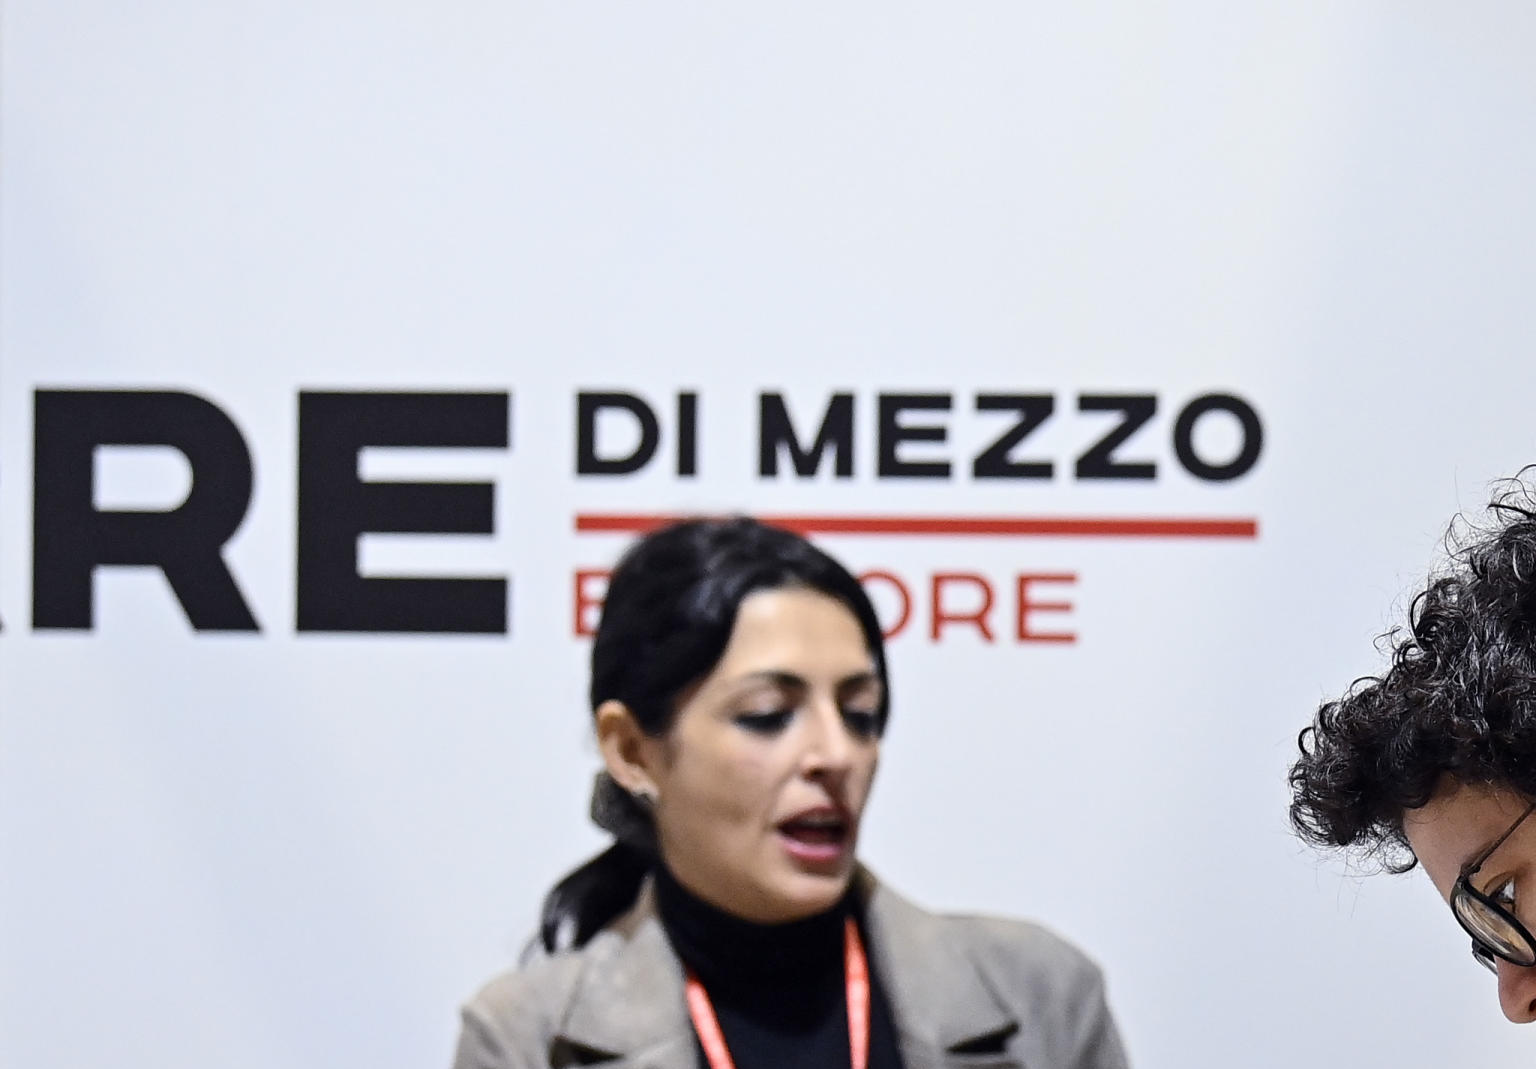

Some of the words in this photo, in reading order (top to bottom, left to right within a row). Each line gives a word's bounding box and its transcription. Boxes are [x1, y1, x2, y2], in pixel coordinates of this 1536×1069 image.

[575, 392, 698, 478] DI
[758, 392, 1265, 484] MEZZO
[0, 388, 511, 634] RE
[572, 569, 1080, 644] EORE
